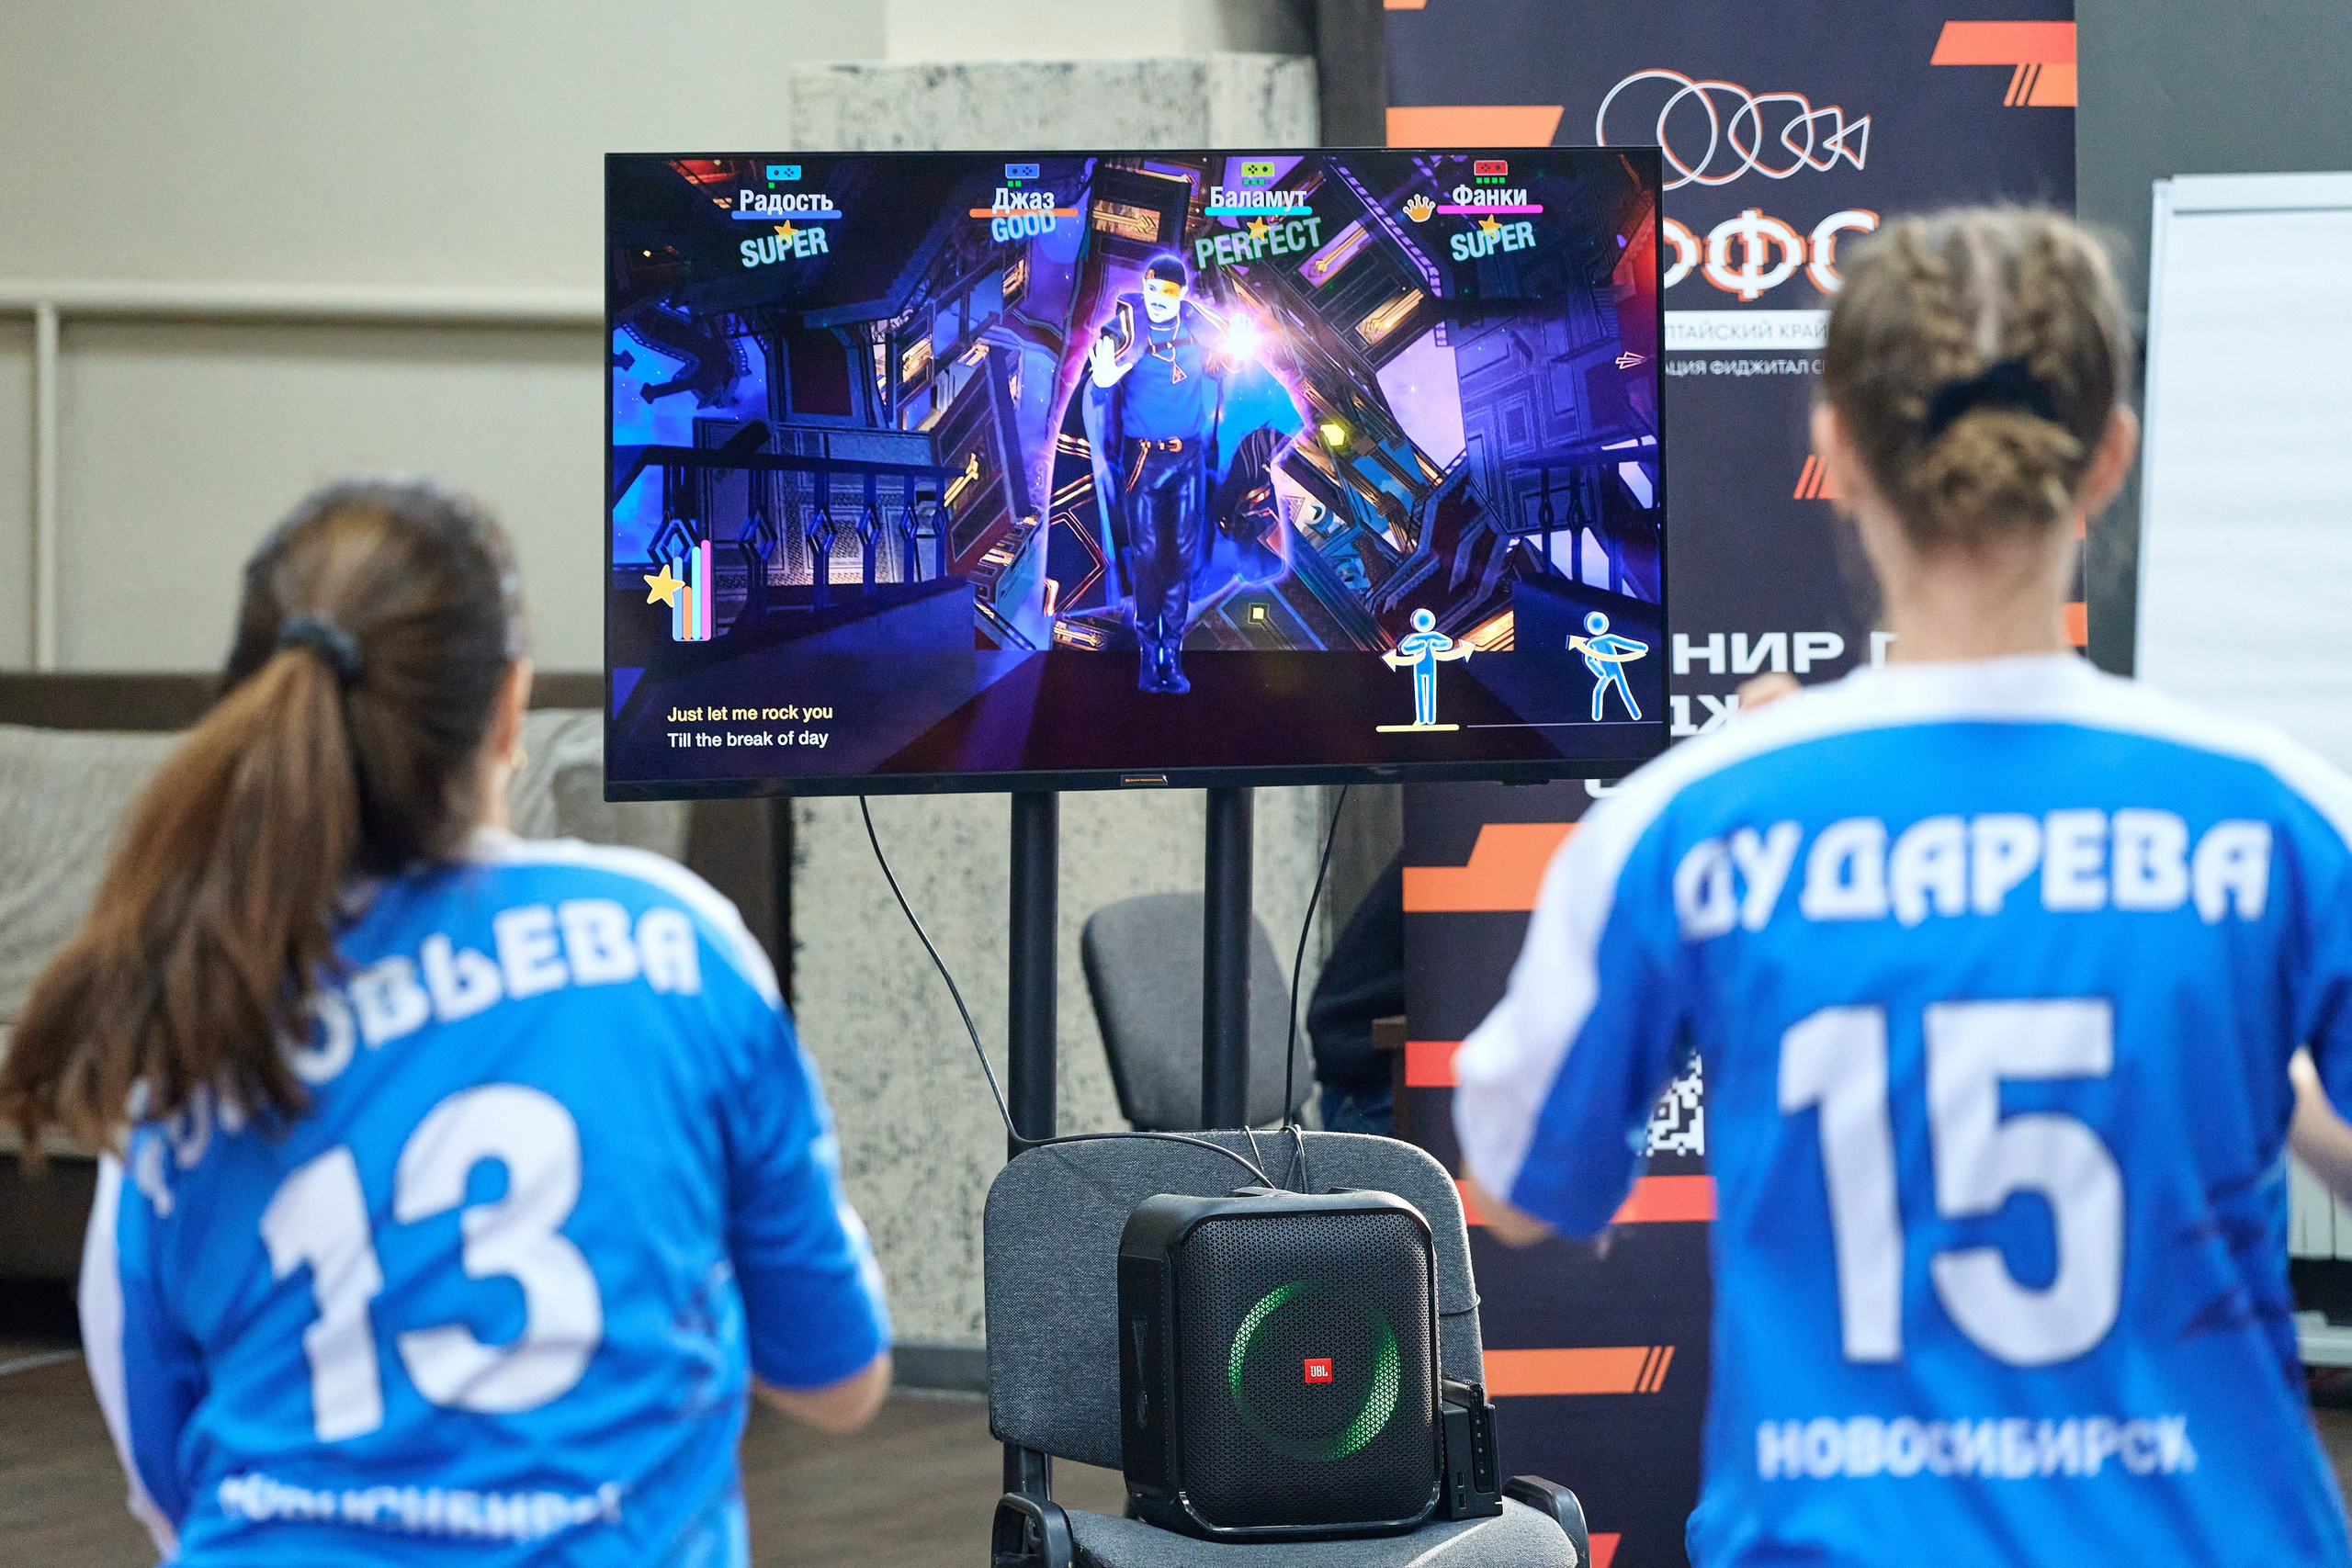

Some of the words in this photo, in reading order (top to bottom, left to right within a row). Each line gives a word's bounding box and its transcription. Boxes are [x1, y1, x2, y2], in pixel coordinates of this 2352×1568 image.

[740, 189, 834, 216] Радость
[992, 187, 1055, 215] Джаз
[1210, 186, 1307, 212] Баламут
[1452, 184, 1528, 207] Фанки
[991, 209, 1057, 243] GOOD
[1450, 220, 1537, 262] SUPER
[739, 226, 830, 268] SUPER
[1194, 216, 1322, 269] PERFECT
[1666, 320, 1773, 341] ЛТАЙСКИЙ
[1709, 359, 1809, 377] ФИДЖИТАЛ
[1672, 632, 1845, 674] НИР
[667, 706, 703, 722] Just
[707, 706, 728, 721] let
[732, 707, 758, 720] me
[762, 705, 798, 720] rock
[802, 706, 833, 723] you
[667, 732, 691, 748] Till
[695, 732, 722, 747] the
[727, 731, 774, 747] break
[777, 730, 795, 746] of
[798, 730, 829, 748] day
[1673, 807, 2272, 939] ДУДАРЕВА
[1777, 998, 2124, 1367] 15
[260, 1083, 603, 1444] 13
[1310, 1365, 1329, 1377] JBL
[1755, 1415, 2199, 1483] НОВОСИБИРСК
